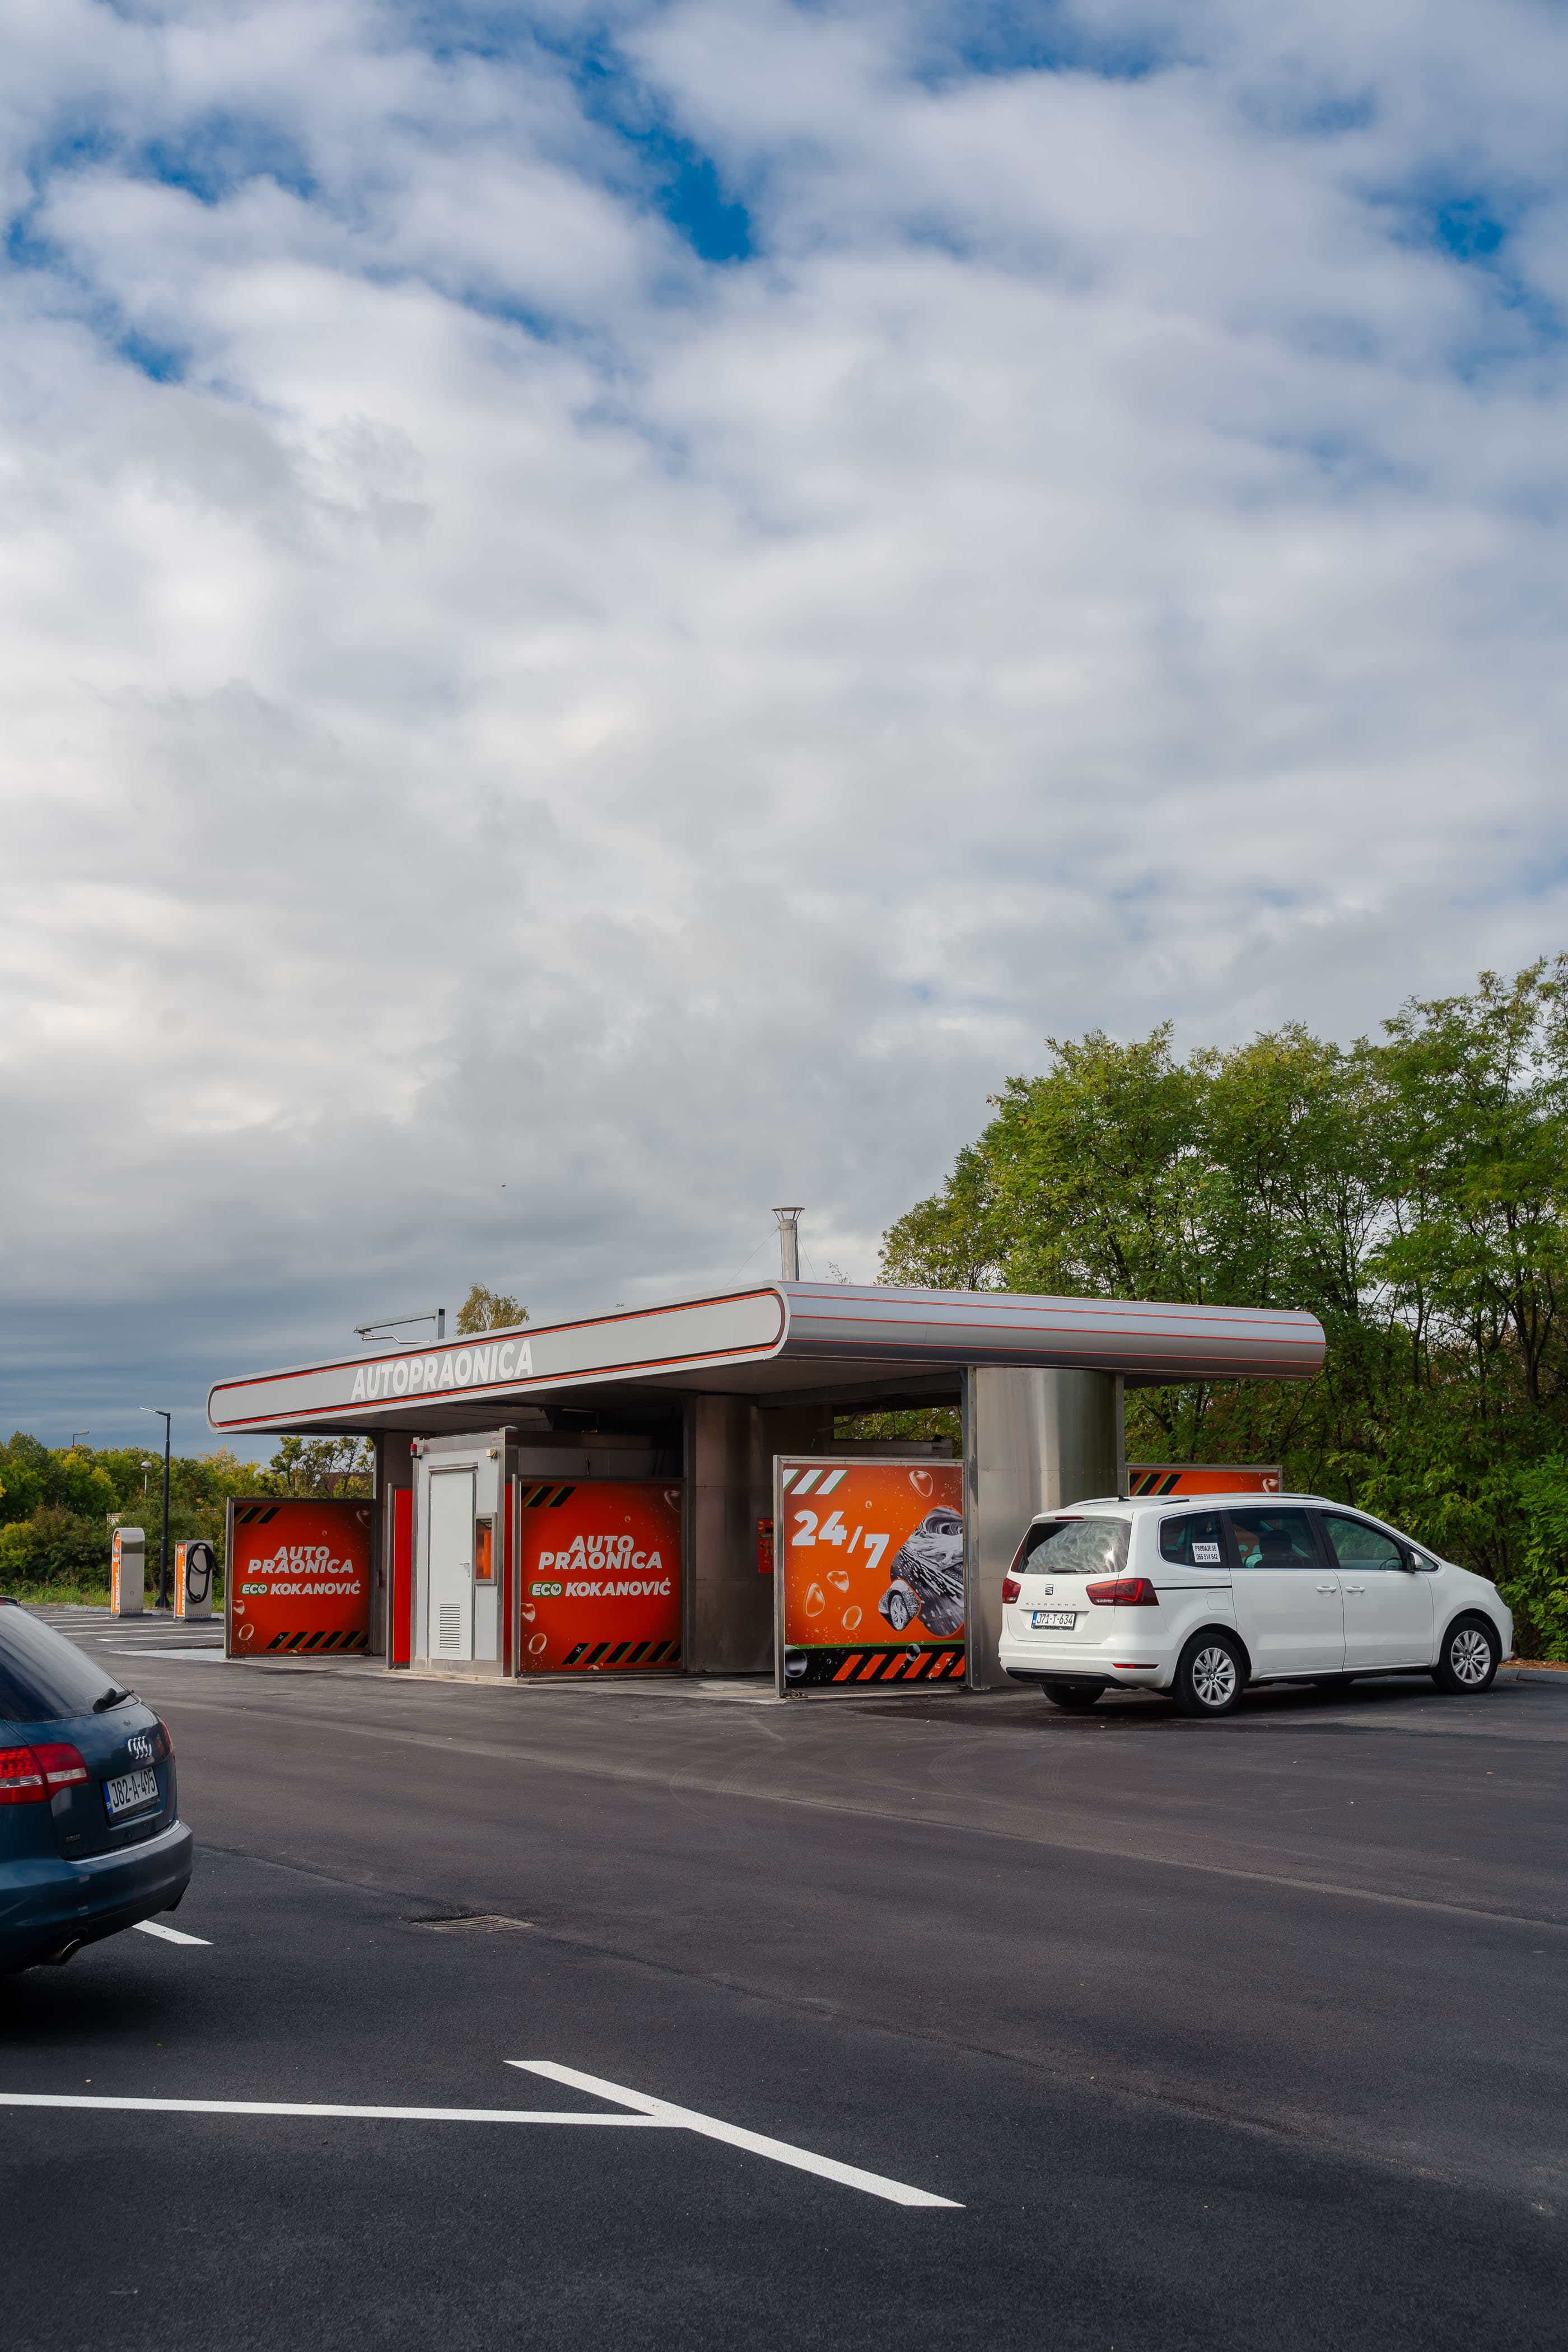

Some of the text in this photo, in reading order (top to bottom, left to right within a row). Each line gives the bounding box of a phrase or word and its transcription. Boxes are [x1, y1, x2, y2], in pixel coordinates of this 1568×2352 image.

[351, 1340, 533, 1402] AUTOPRAONICA
[568, 1535, 634, 1553] AUTO
[792, 1510, 890, 1568] 24/7
[273, 1546, 330, 1560] AUTO
[538, 1551, 662, 1570] PRAONICA
[248, 1559, 353, 1574] PRAONICA
[242, 1580, 361, 1595] ECO KOKANOVIĆ
[531, 1577, 671, 1597] ECO KOKANOVIĆ
[1037, 1613, 1074, 1625] J71-T-634
[111, 1768, 155, 1808] J82-A-495
